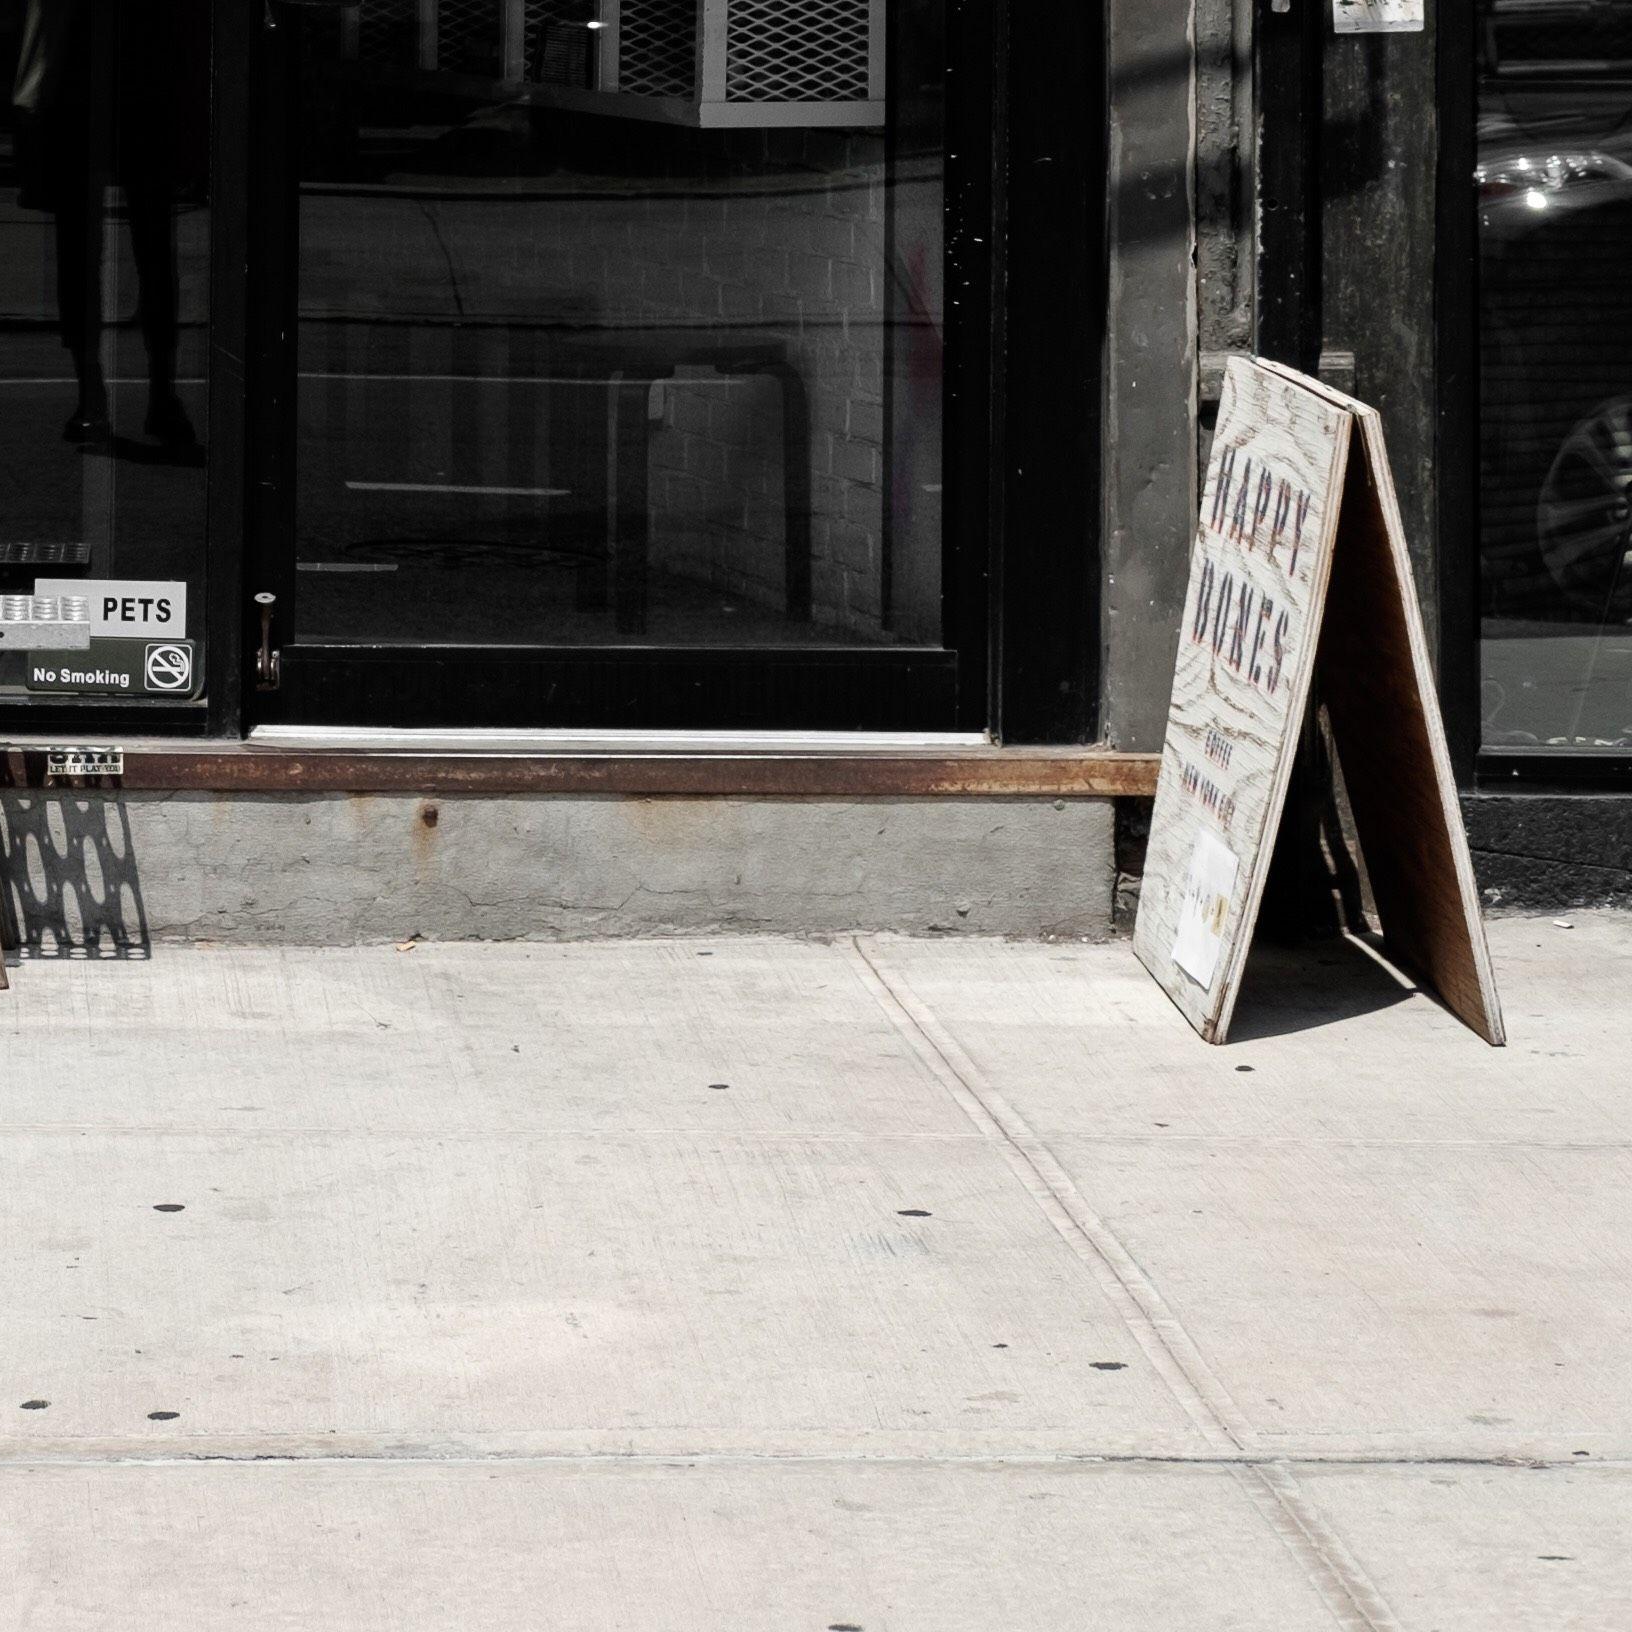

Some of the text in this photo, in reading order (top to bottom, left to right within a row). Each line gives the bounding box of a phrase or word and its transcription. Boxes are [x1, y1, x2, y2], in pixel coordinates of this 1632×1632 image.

[1211, 445, 1311, 577] HAPPY
[103, 597, 172, 623] PETS
[1193, 558, 1289, 694] BONES
[33, 667, 130, 687] No Smoking
